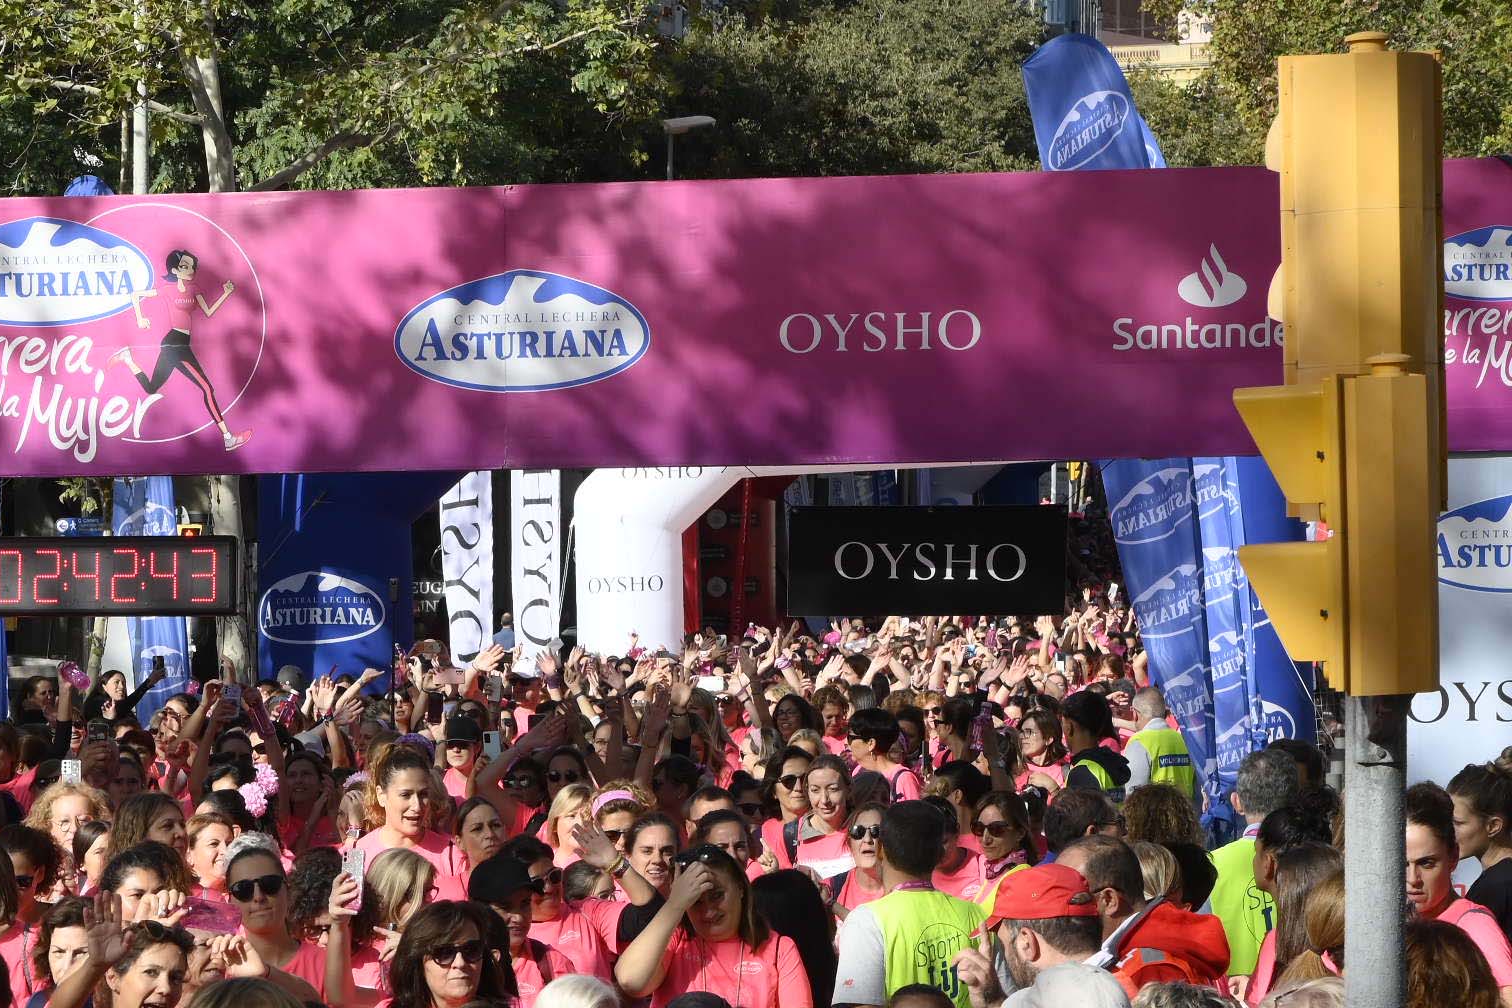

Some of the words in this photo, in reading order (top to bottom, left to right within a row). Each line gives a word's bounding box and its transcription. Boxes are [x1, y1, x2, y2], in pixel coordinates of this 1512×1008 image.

[54, 254, 129, 265] LECHERA
[454, 312, 533, 325] CENTRAL
[541, 311, 622, 323] LECHERA
[779, 309, 982, 353] OYSHO
[414, 317, 630, 361] ASTURIANA
[1463, 337, 1480, 364] la
[15, 366, 163, 463] Mujer
[1460, 530, 1512, 540] CENTR
[834, 540, 1027, 581] OYSHO
[588, 574, 664, 594] OYSHO
[277, 596, 317, 604] CENTRAL
[264, 601, 376, 628] ASTURIANA
[917, 931, 962, 968] Sport
